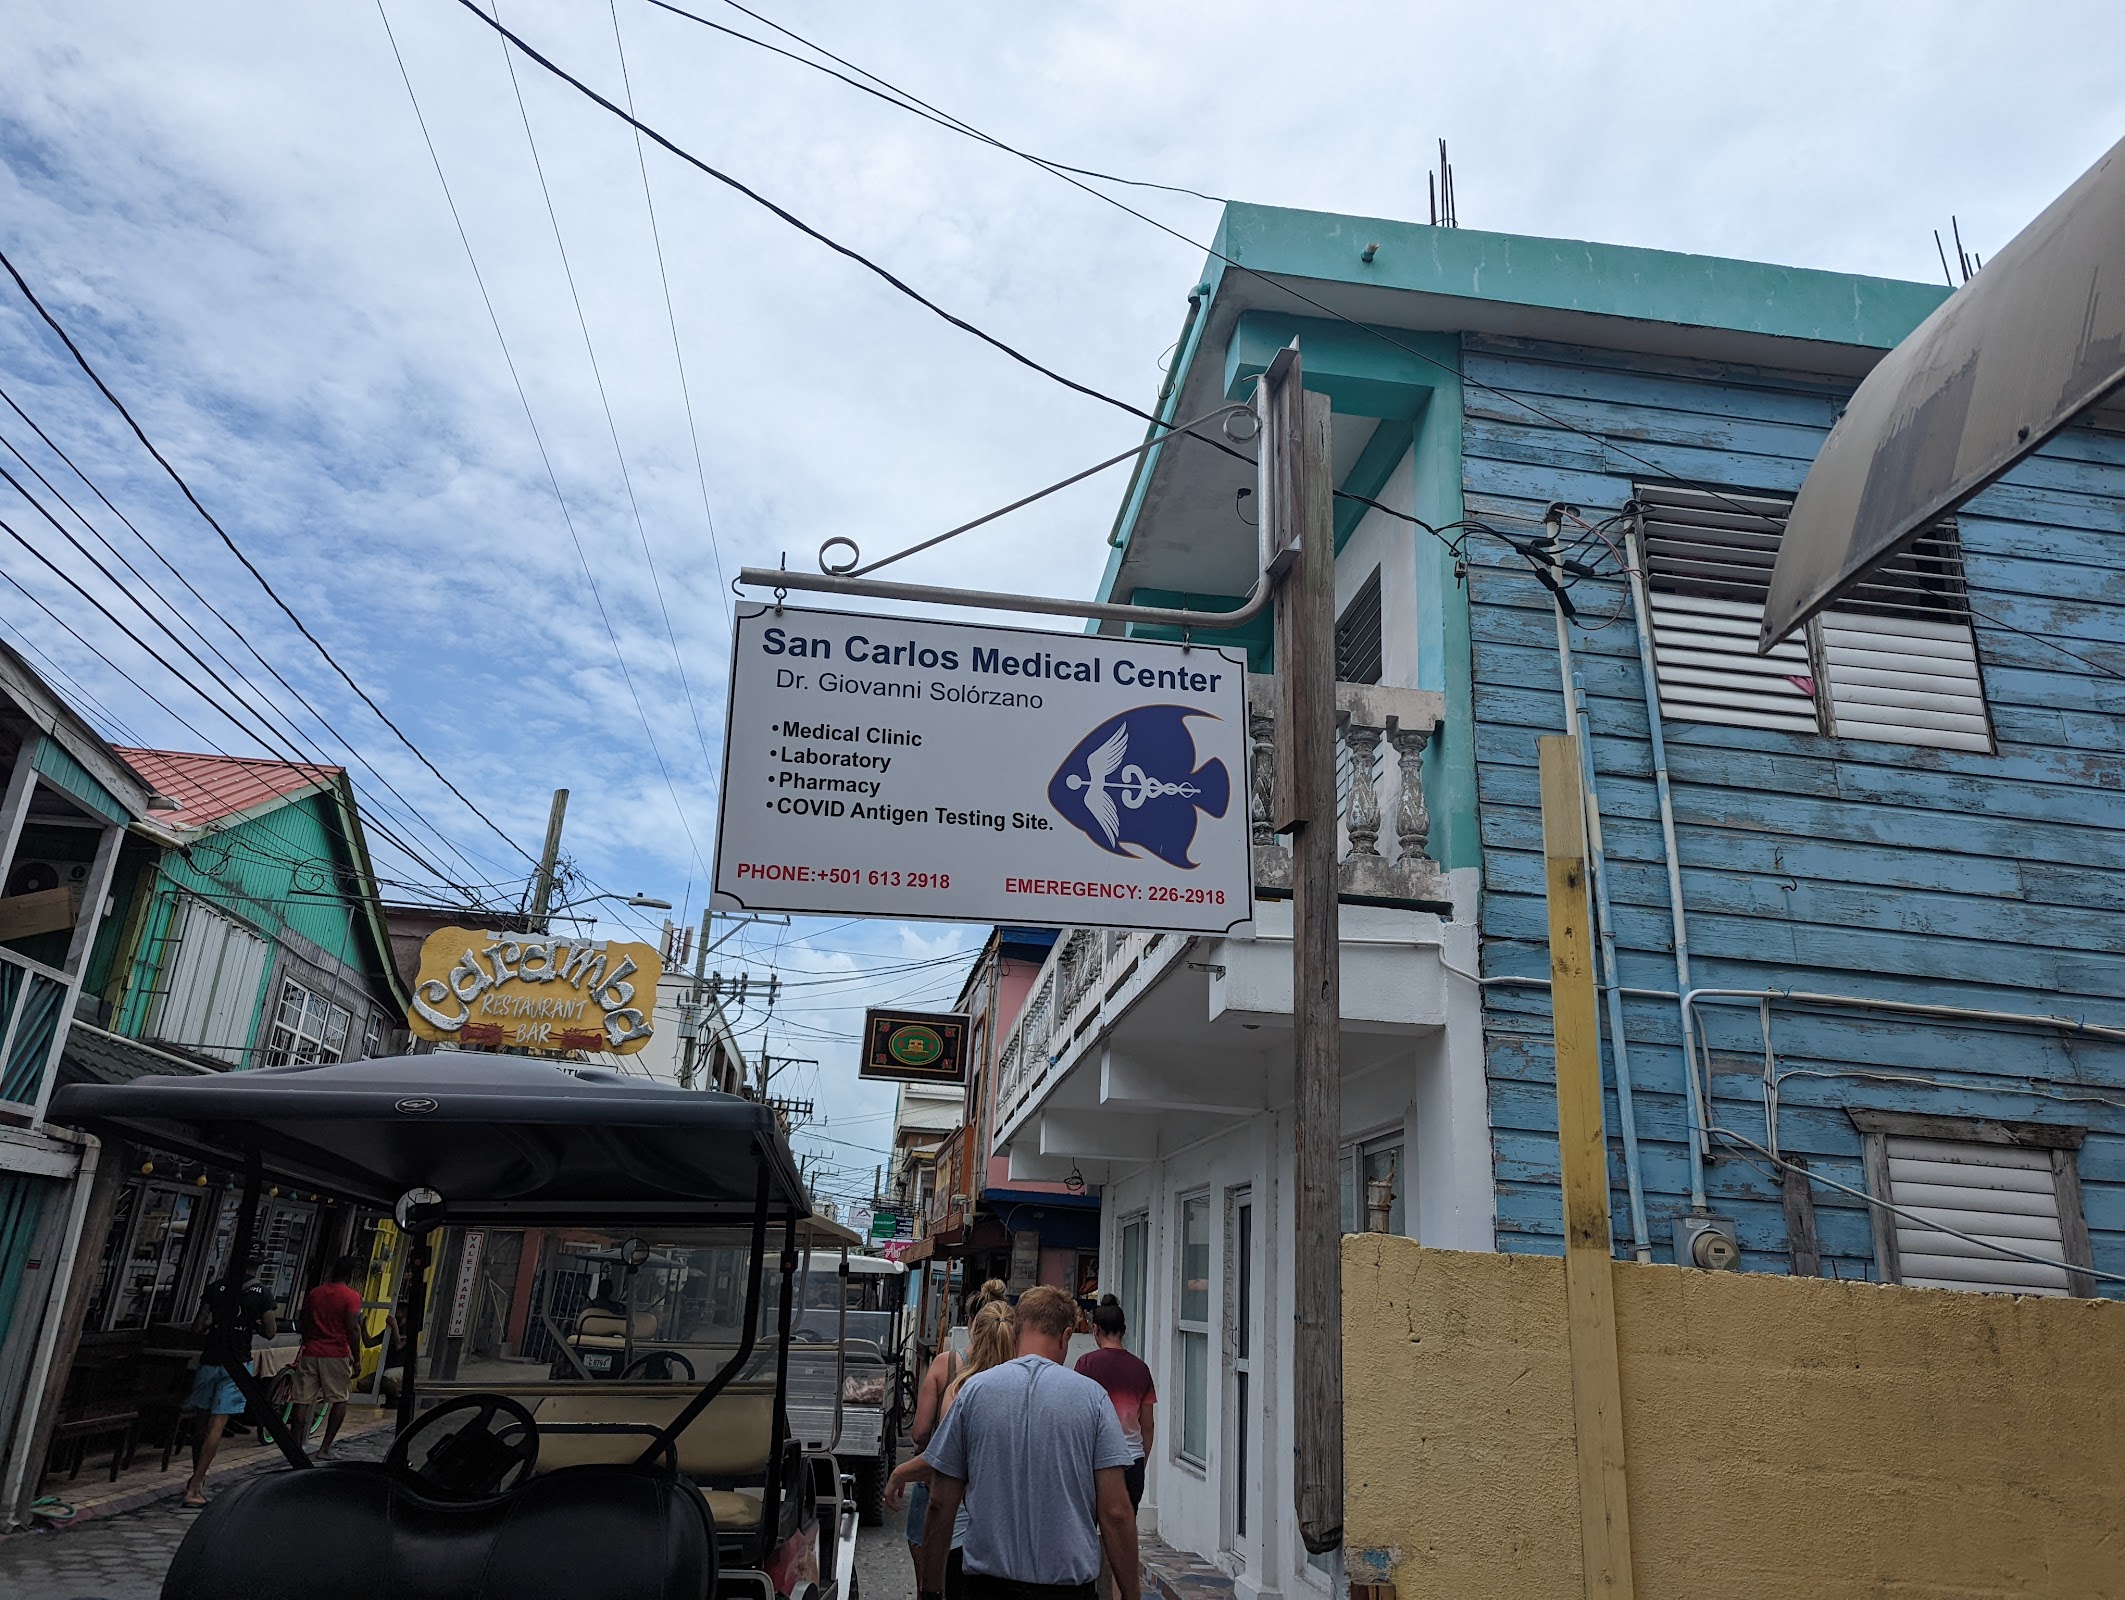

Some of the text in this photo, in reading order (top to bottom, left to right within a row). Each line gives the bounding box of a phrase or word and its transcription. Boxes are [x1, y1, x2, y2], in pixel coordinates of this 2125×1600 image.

[762, 627, 1222, 693] San Carlos Medical Center
[776, 668, 1043, 709] Dr. Giovanni Solórzano
[783, 720, 922, 747] Medical Clinic
[781, 746, 891, 773] Laboratory
[779, 771, 881, 798] Pharmacy
[777, 797, 1054, 832] COVID Antigen Testing Site.
[868, 870, 901, 887] 613
[906, 872, 950, 889] 2918
[1005, 877, 1225, 905] EMEREGENCY: 226-2918
[412, 939, 654, 1047] Caramba
[480, 993, 589, 1021] RESTAURANT
[515, 1023, 553, 1044] BAR
[454, 1236, 477, 1334] VALET PARKING
